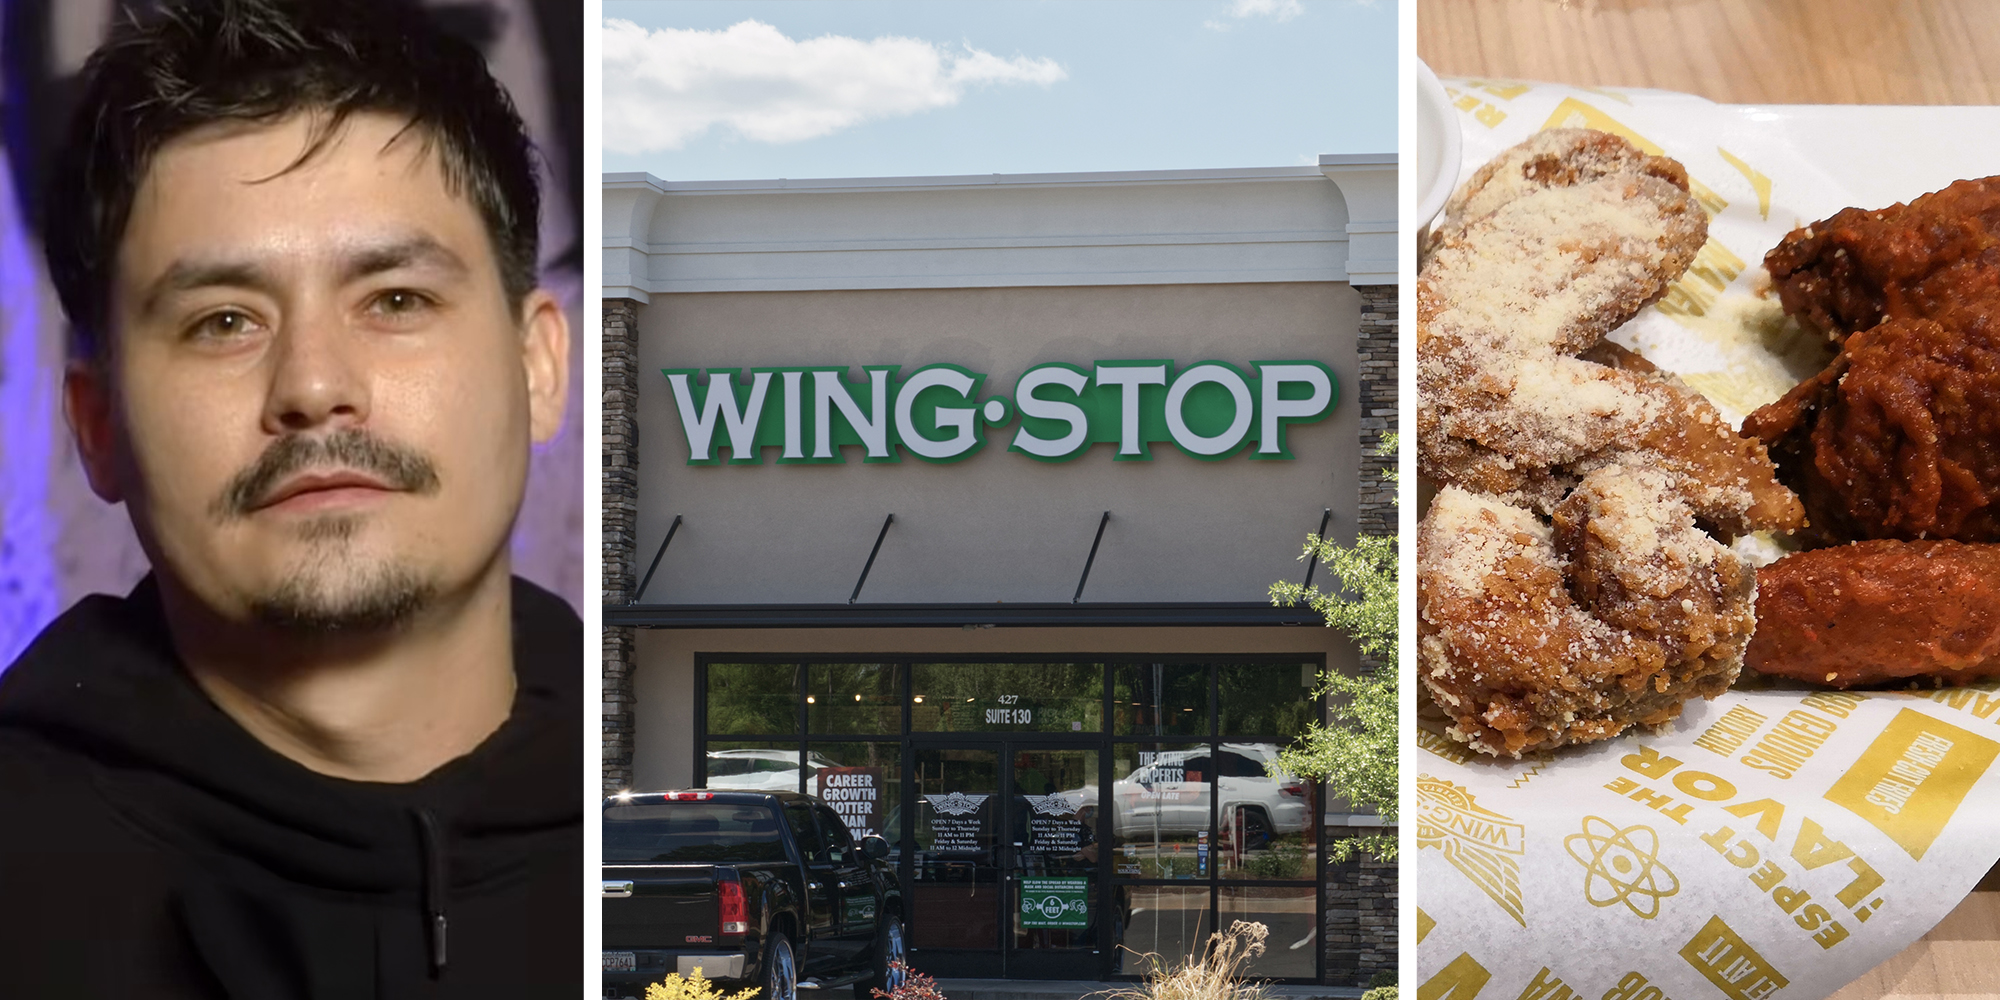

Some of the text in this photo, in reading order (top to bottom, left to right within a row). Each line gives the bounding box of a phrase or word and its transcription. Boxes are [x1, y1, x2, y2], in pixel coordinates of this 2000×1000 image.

[997, 694, 1019, 705] 427
[985, 708, 1032, 724] SUITE 130
[1692, 703, 1769, 759] HICKORY
[1740, 709, 1838, 780] SMOKED
[1138, 751, 1156, 766] THE
[1139, 768, 1184, 783] EXPERTS
[1864, 730, 1955, 815] FRESH-CUT FRIES
[826, 774, 873, 788] CAREER
[822, 787, 877, 801] GROWTH
[1140, 791, 1180, 800] OPEN LATE
[839, 815, 866, 828] HAN
[1416, 799, 1510, 847] WING·
[849, 828, 874, 841] MIC
[1619, 744, 1886, 924] LAVOR
[1602, 775, 1850, 950] ESPECT THE
[1045, 906, 1060, 914] FEET
[685, 935, 713, 943] GMC
[1696, 935, 1782, 1000] ET AT IT
